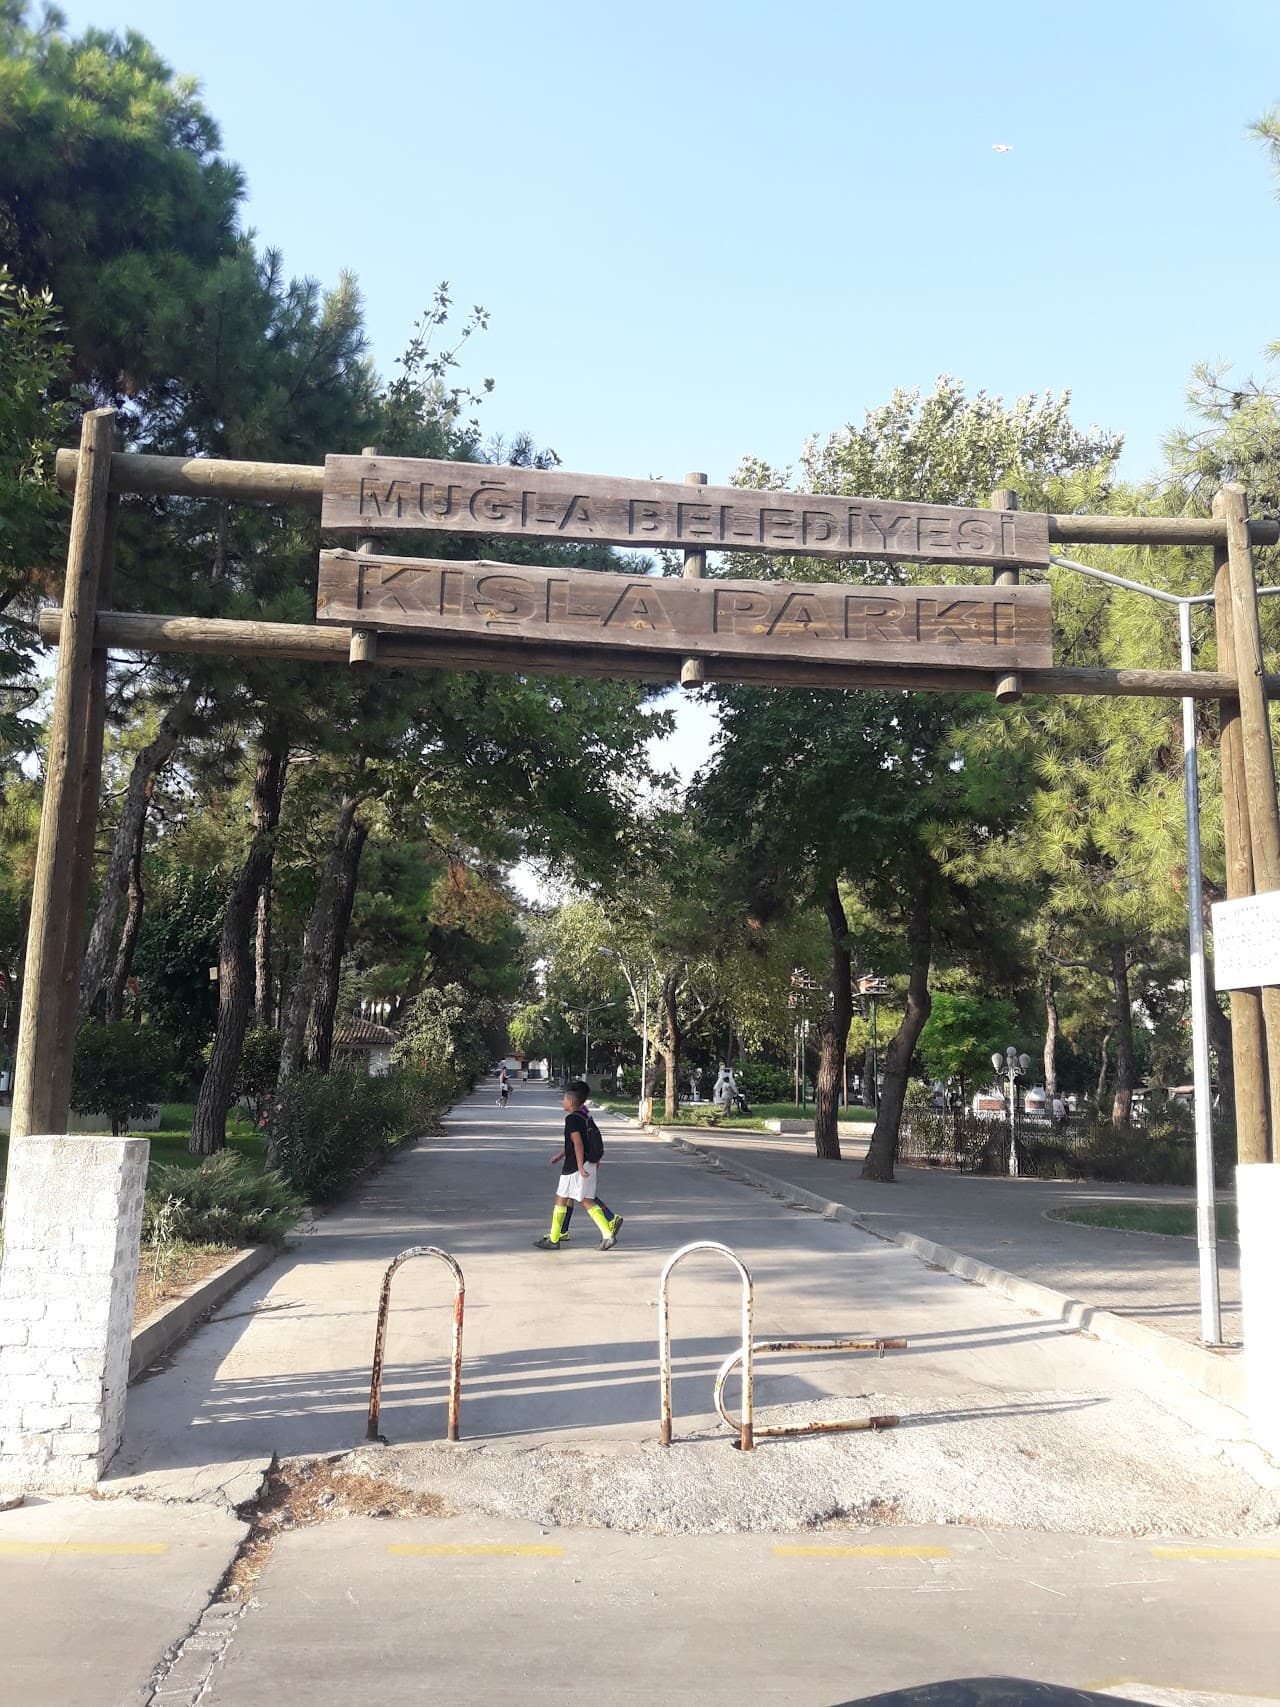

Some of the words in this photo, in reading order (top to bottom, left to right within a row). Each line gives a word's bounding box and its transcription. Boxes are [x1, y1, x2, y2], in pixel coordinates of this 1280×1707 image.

[358, 476, 594, 533] MUĞLA
[627, 499, 1017, 556] BELEDİYESİ
[356, 563, 676, 632] KIŞLA
[712, 588, 1017, 646] PARKI
